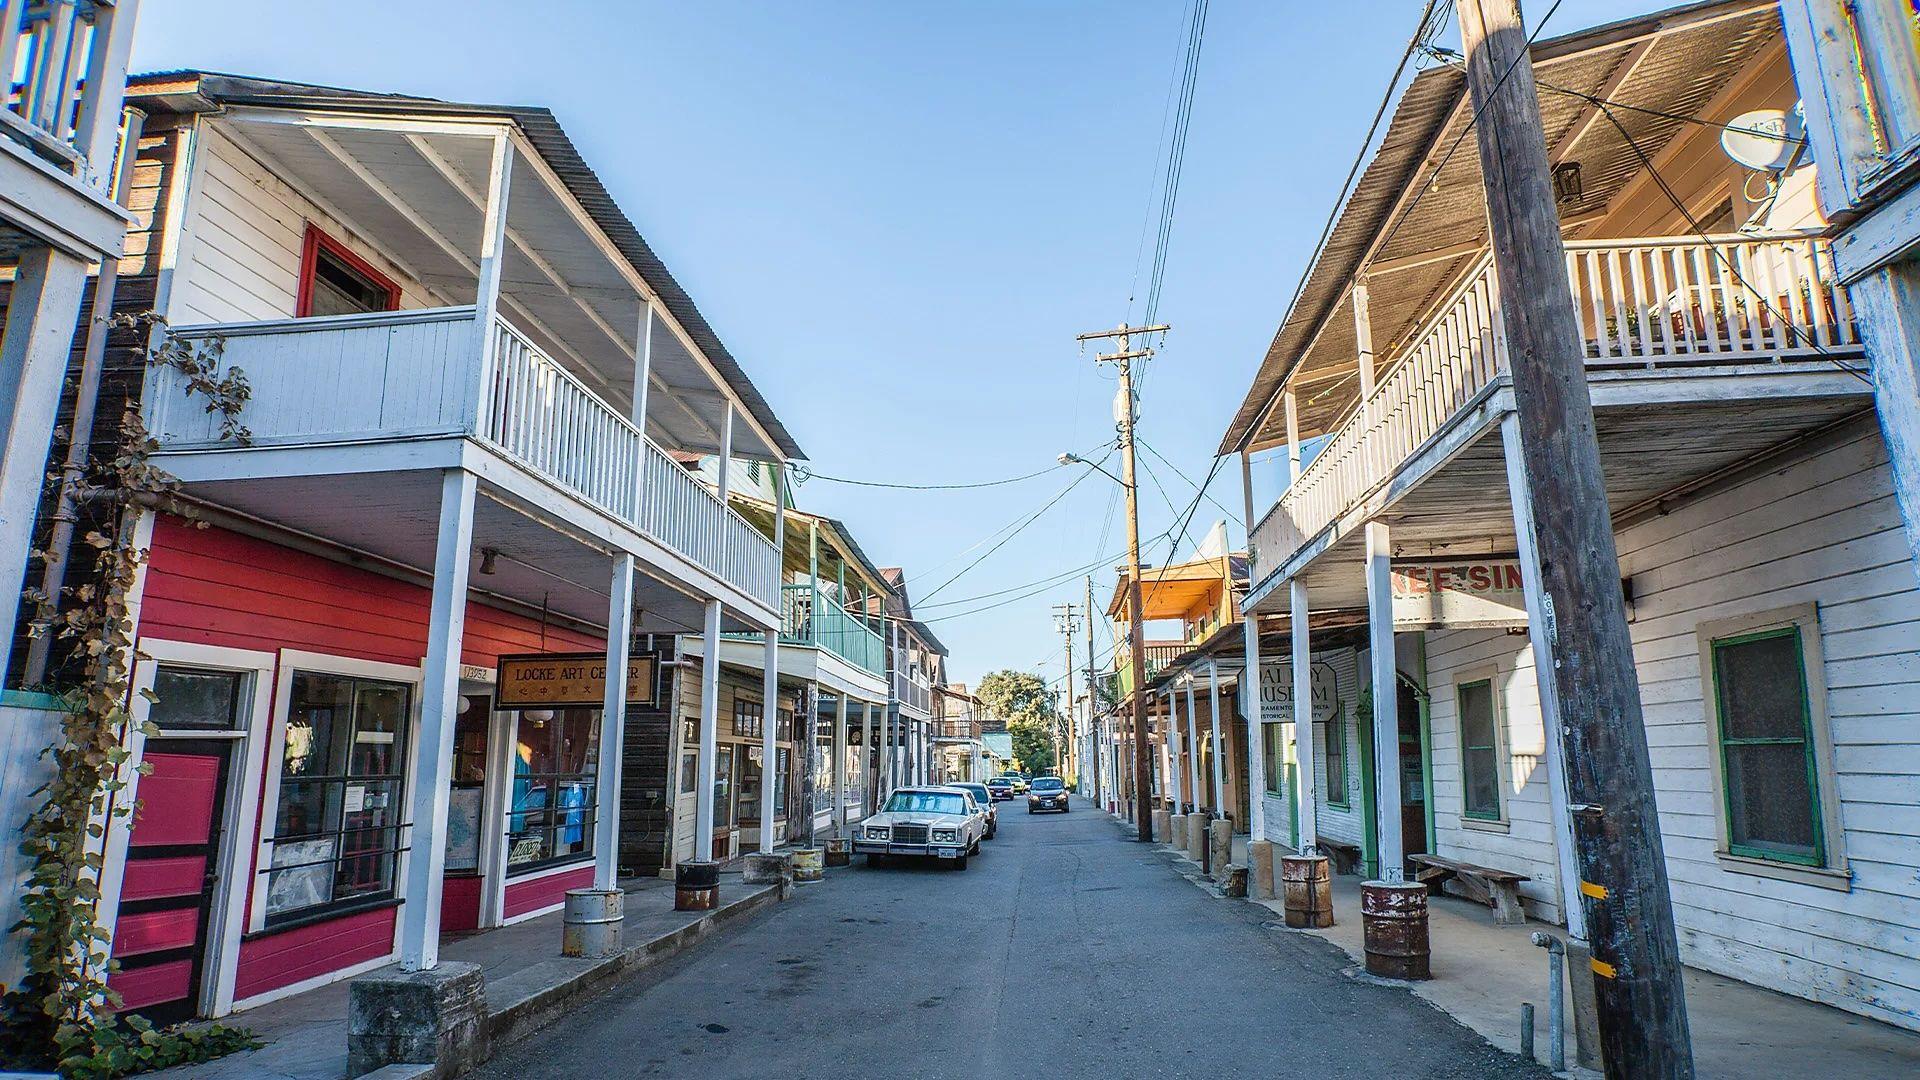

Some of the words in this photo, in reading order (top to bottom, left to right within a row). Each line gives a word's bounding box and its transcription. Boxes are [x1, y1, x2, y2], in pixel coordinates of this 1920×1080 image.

[1468, 565, 1523, 590] SIN
[516, 668, 556, 681] LOCKE
[560, 667, 584, 680] ART
[1260, 685, 1327, 702] USEM
